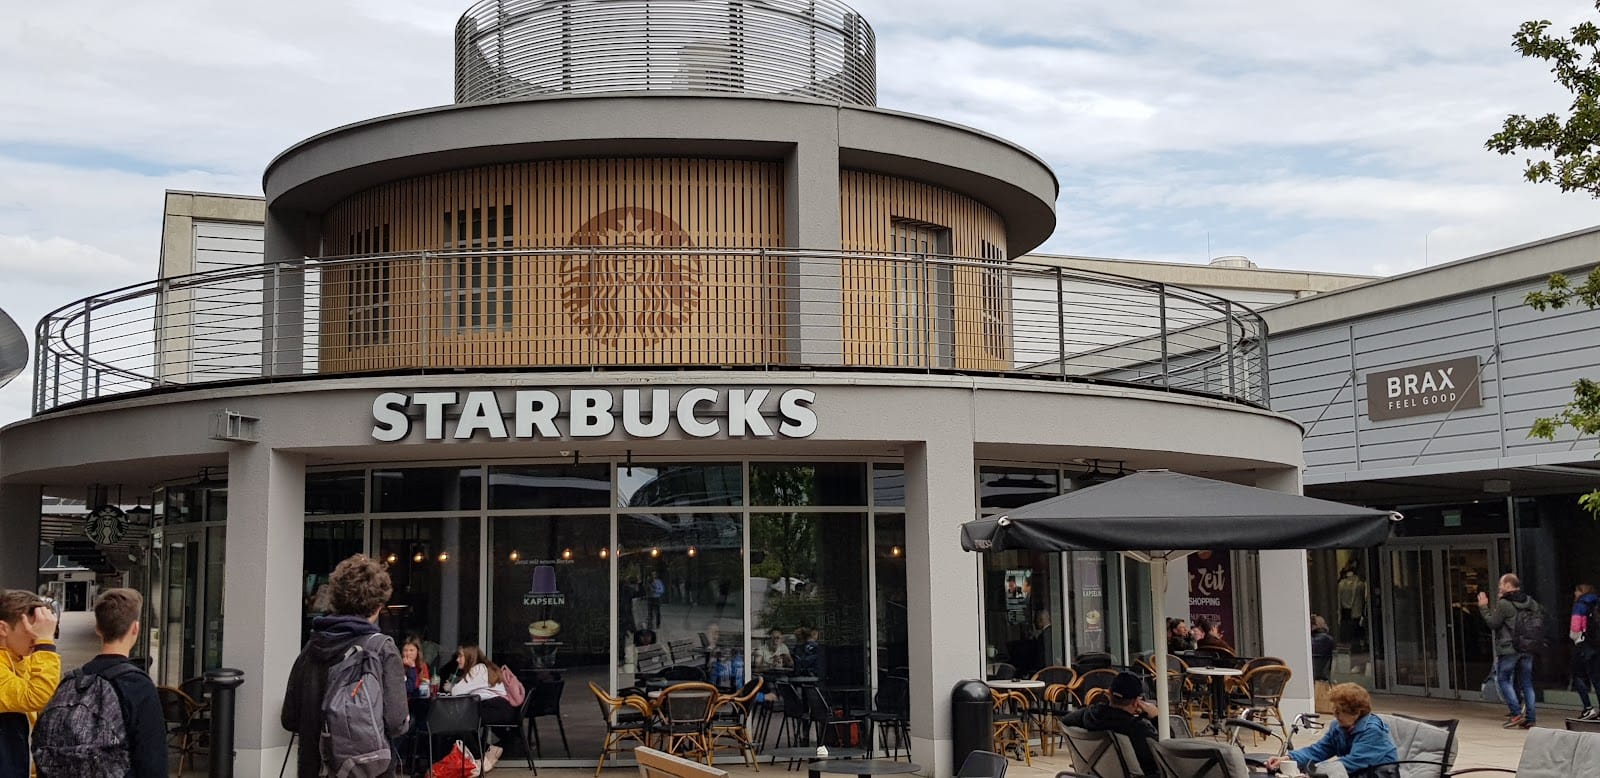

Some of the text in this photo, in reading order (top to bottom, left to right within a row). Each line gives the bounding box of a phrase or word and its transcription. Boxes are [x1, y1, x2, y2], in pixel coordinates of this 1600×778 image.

[1387, 367, 1455, 398] BRAX
[1388, 392, 1457, 410] FEEL GOOD
[371, 387, 819, 441] STARBUCKS
[1198, 564, 1225, 596] Zeit
[523, 597, 565, 606] KAPSELN
[1188, 597, 1221, 606] SHOPPING
